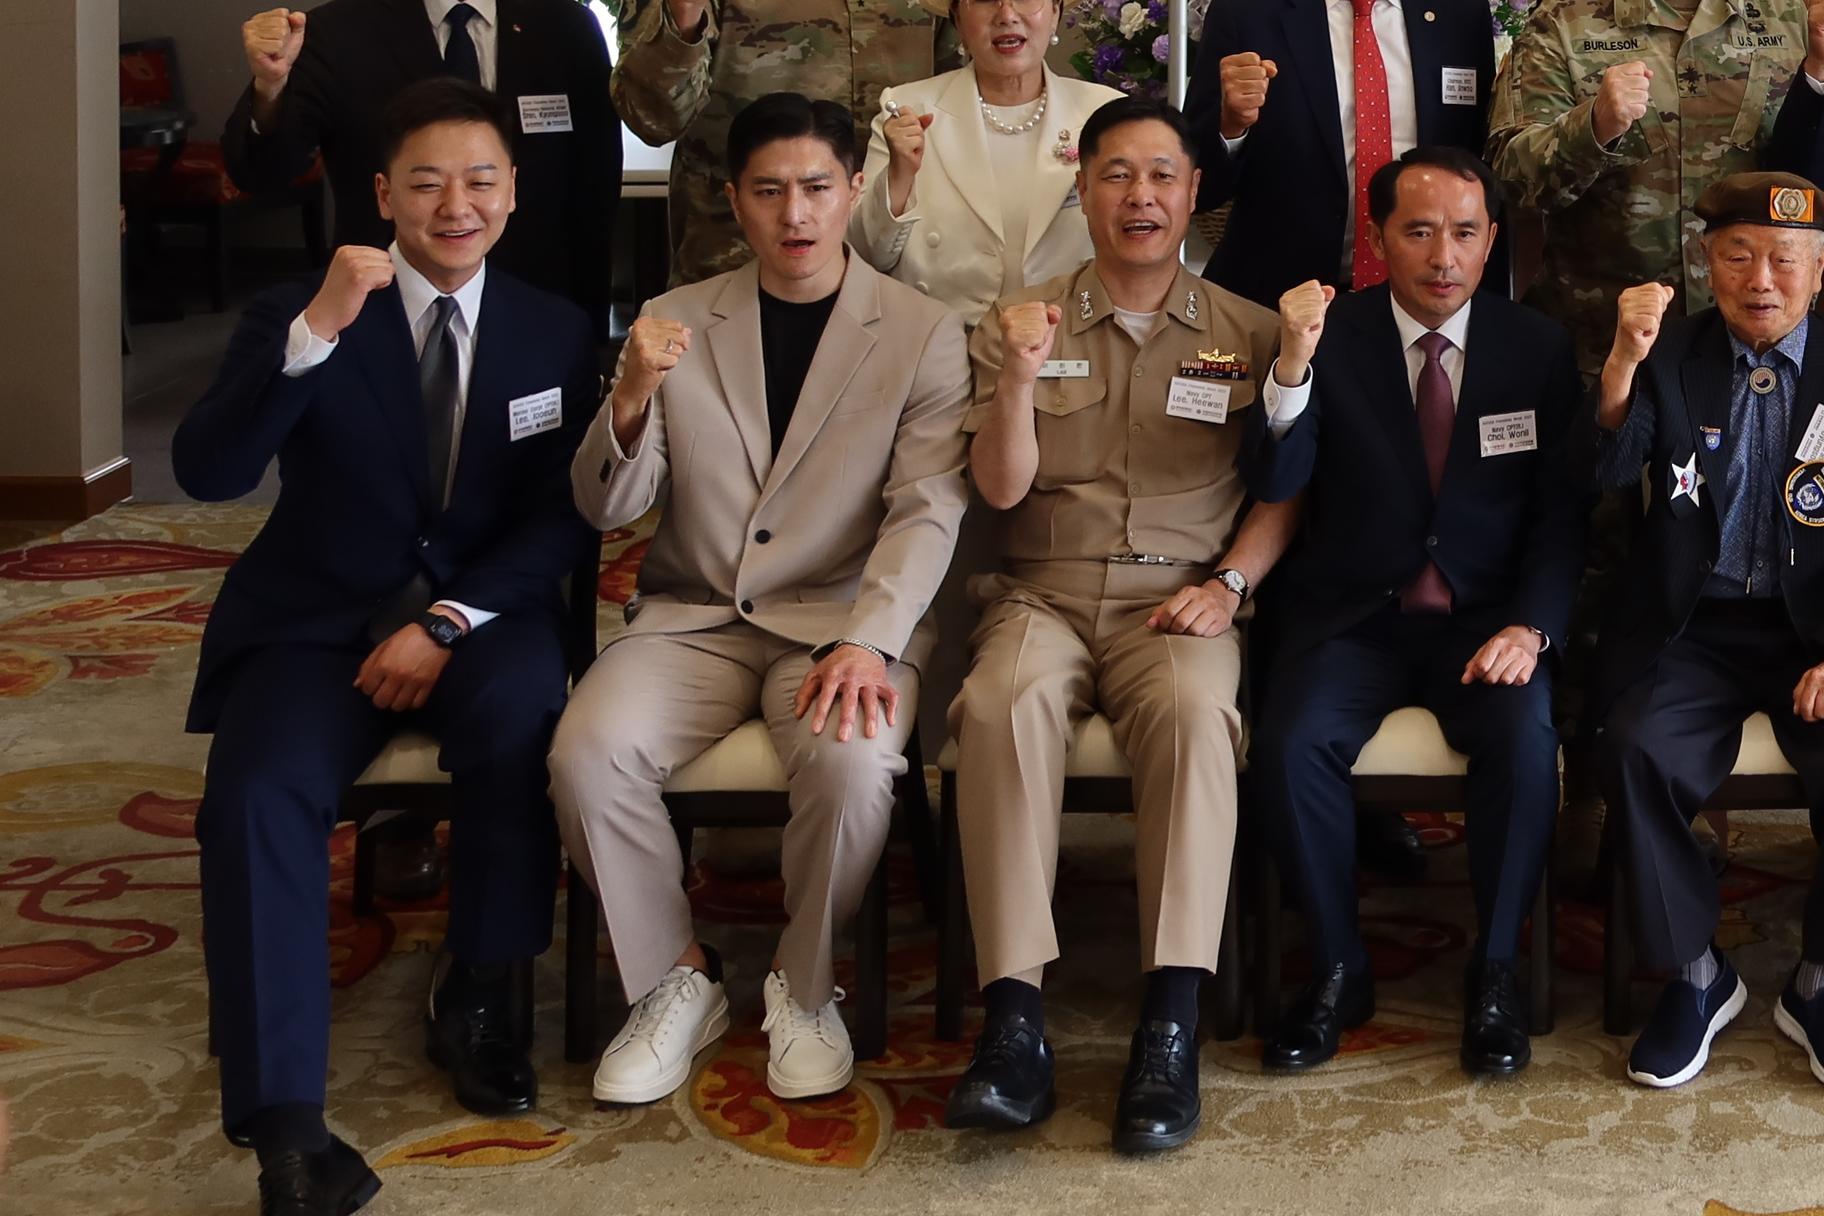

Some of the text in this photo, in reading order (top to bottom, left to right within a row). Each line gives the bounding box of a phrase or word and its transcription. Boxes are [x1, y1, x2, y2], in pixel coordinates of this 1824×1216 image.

[1584, 39, 1639, 51] BURLESON
[1737, 35, 1784, 47] U.S. ARMY
